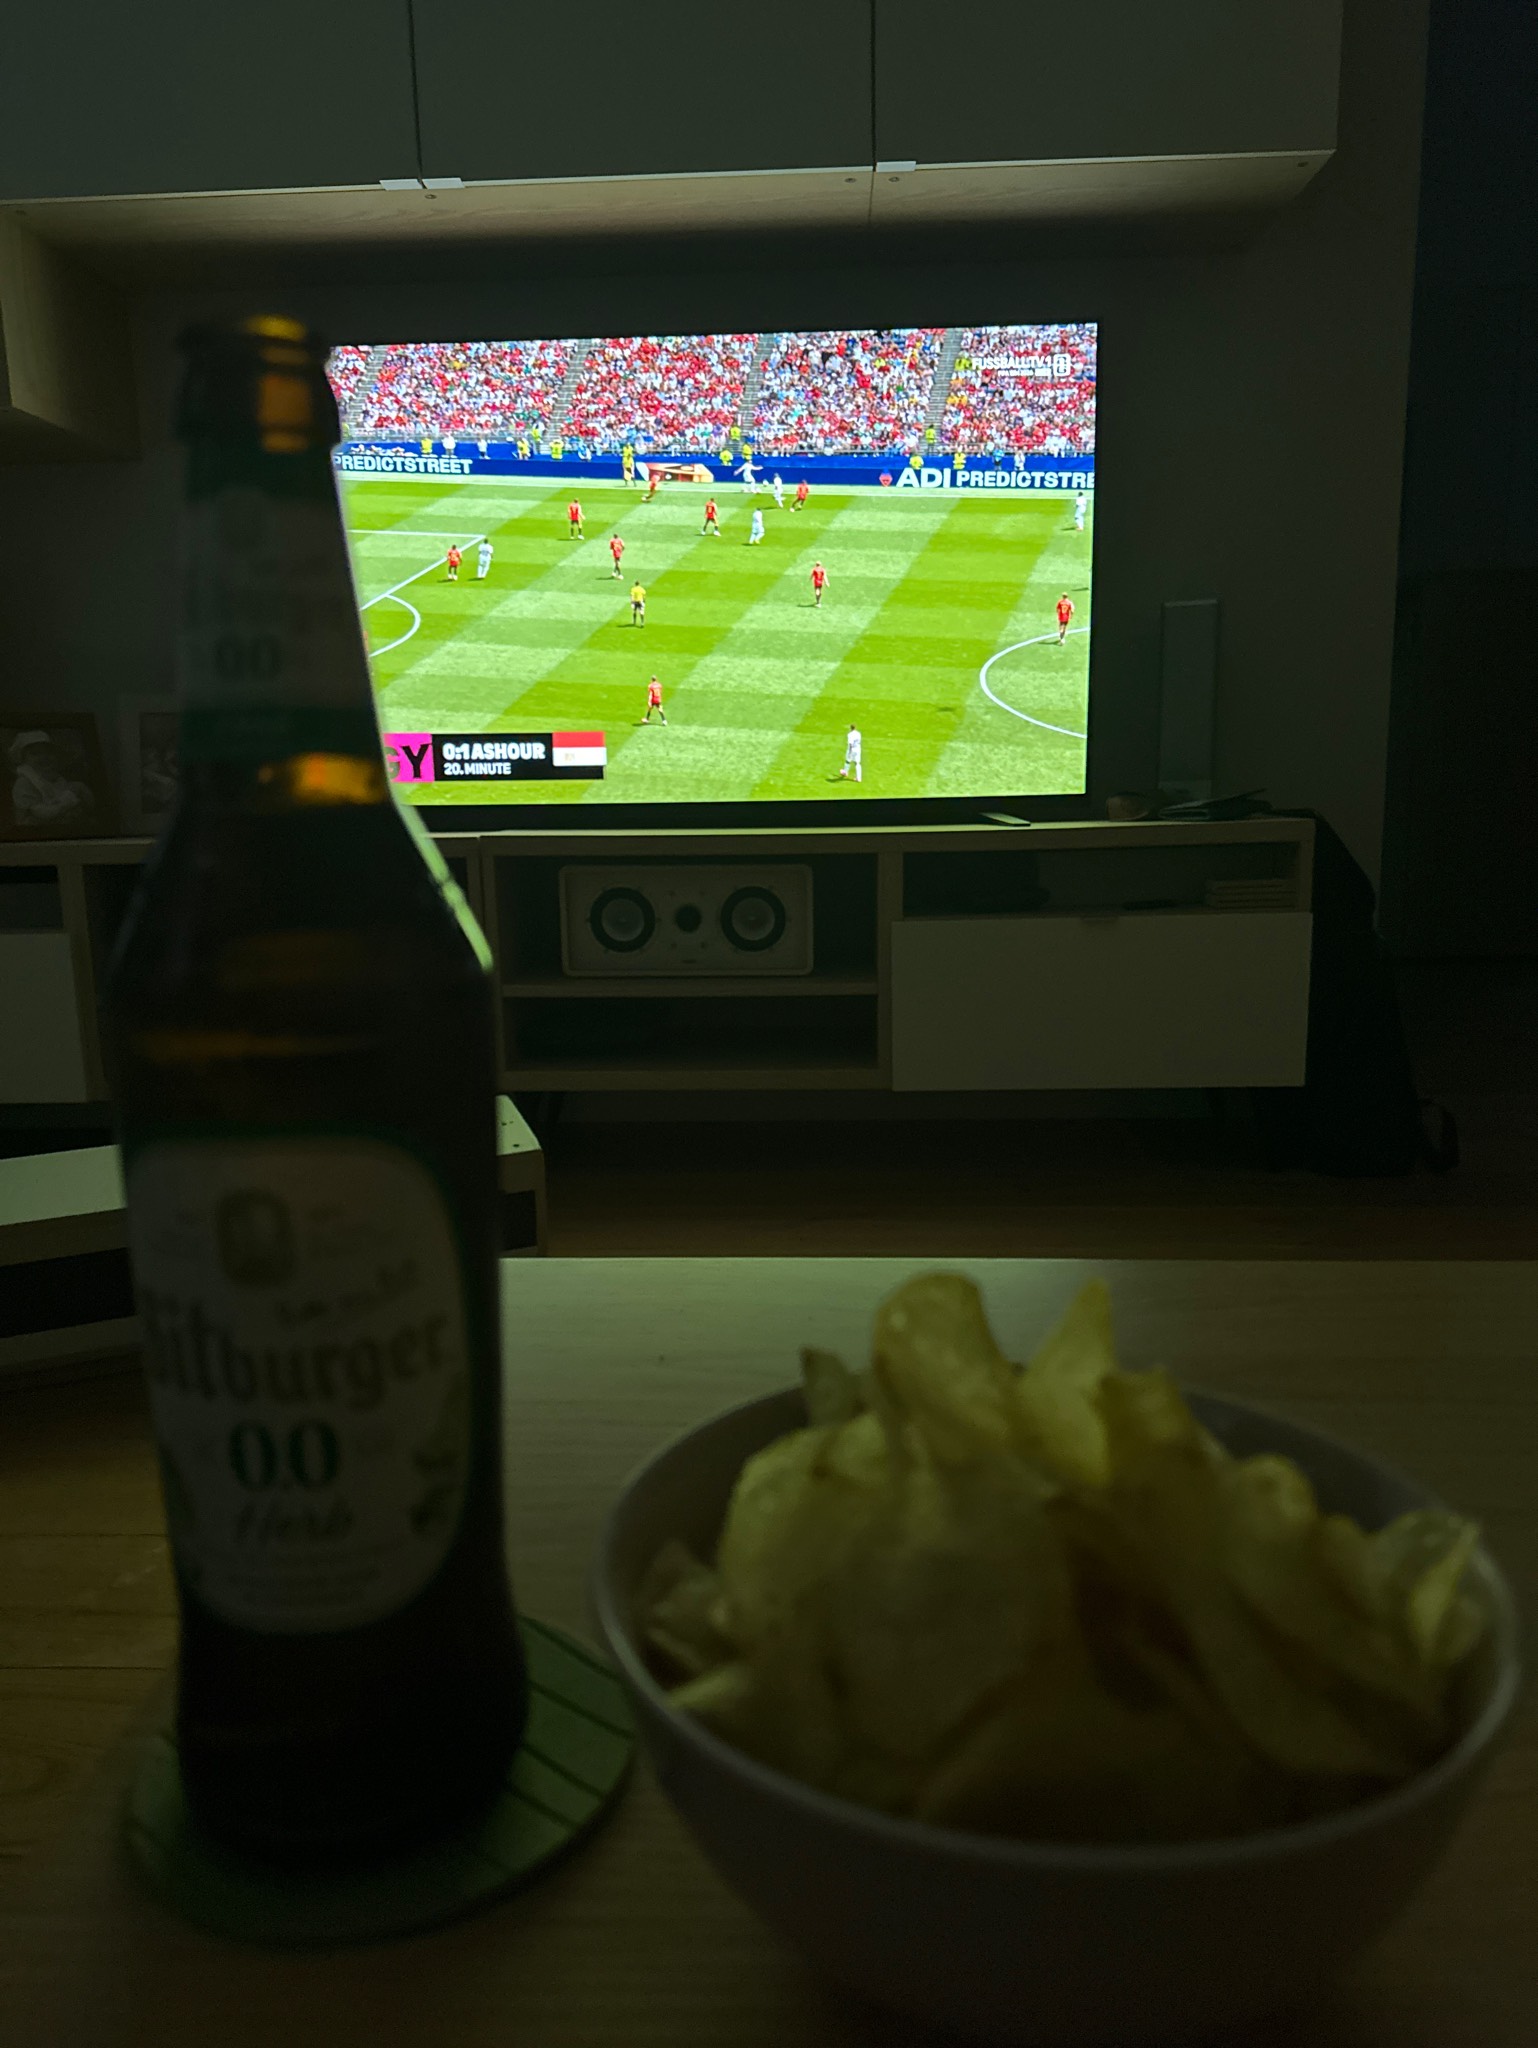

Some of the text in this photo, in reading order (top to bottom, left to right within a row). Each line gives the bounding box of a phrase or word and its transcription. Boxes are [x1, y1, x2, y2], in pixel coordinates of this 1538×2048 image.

[896, 467, 1095, 489] ADI PREDICTSTRE
[442, 742, 546, 760] 0:1 ASHOUR
[443, 762, 512, 776] 20. MINUTE
